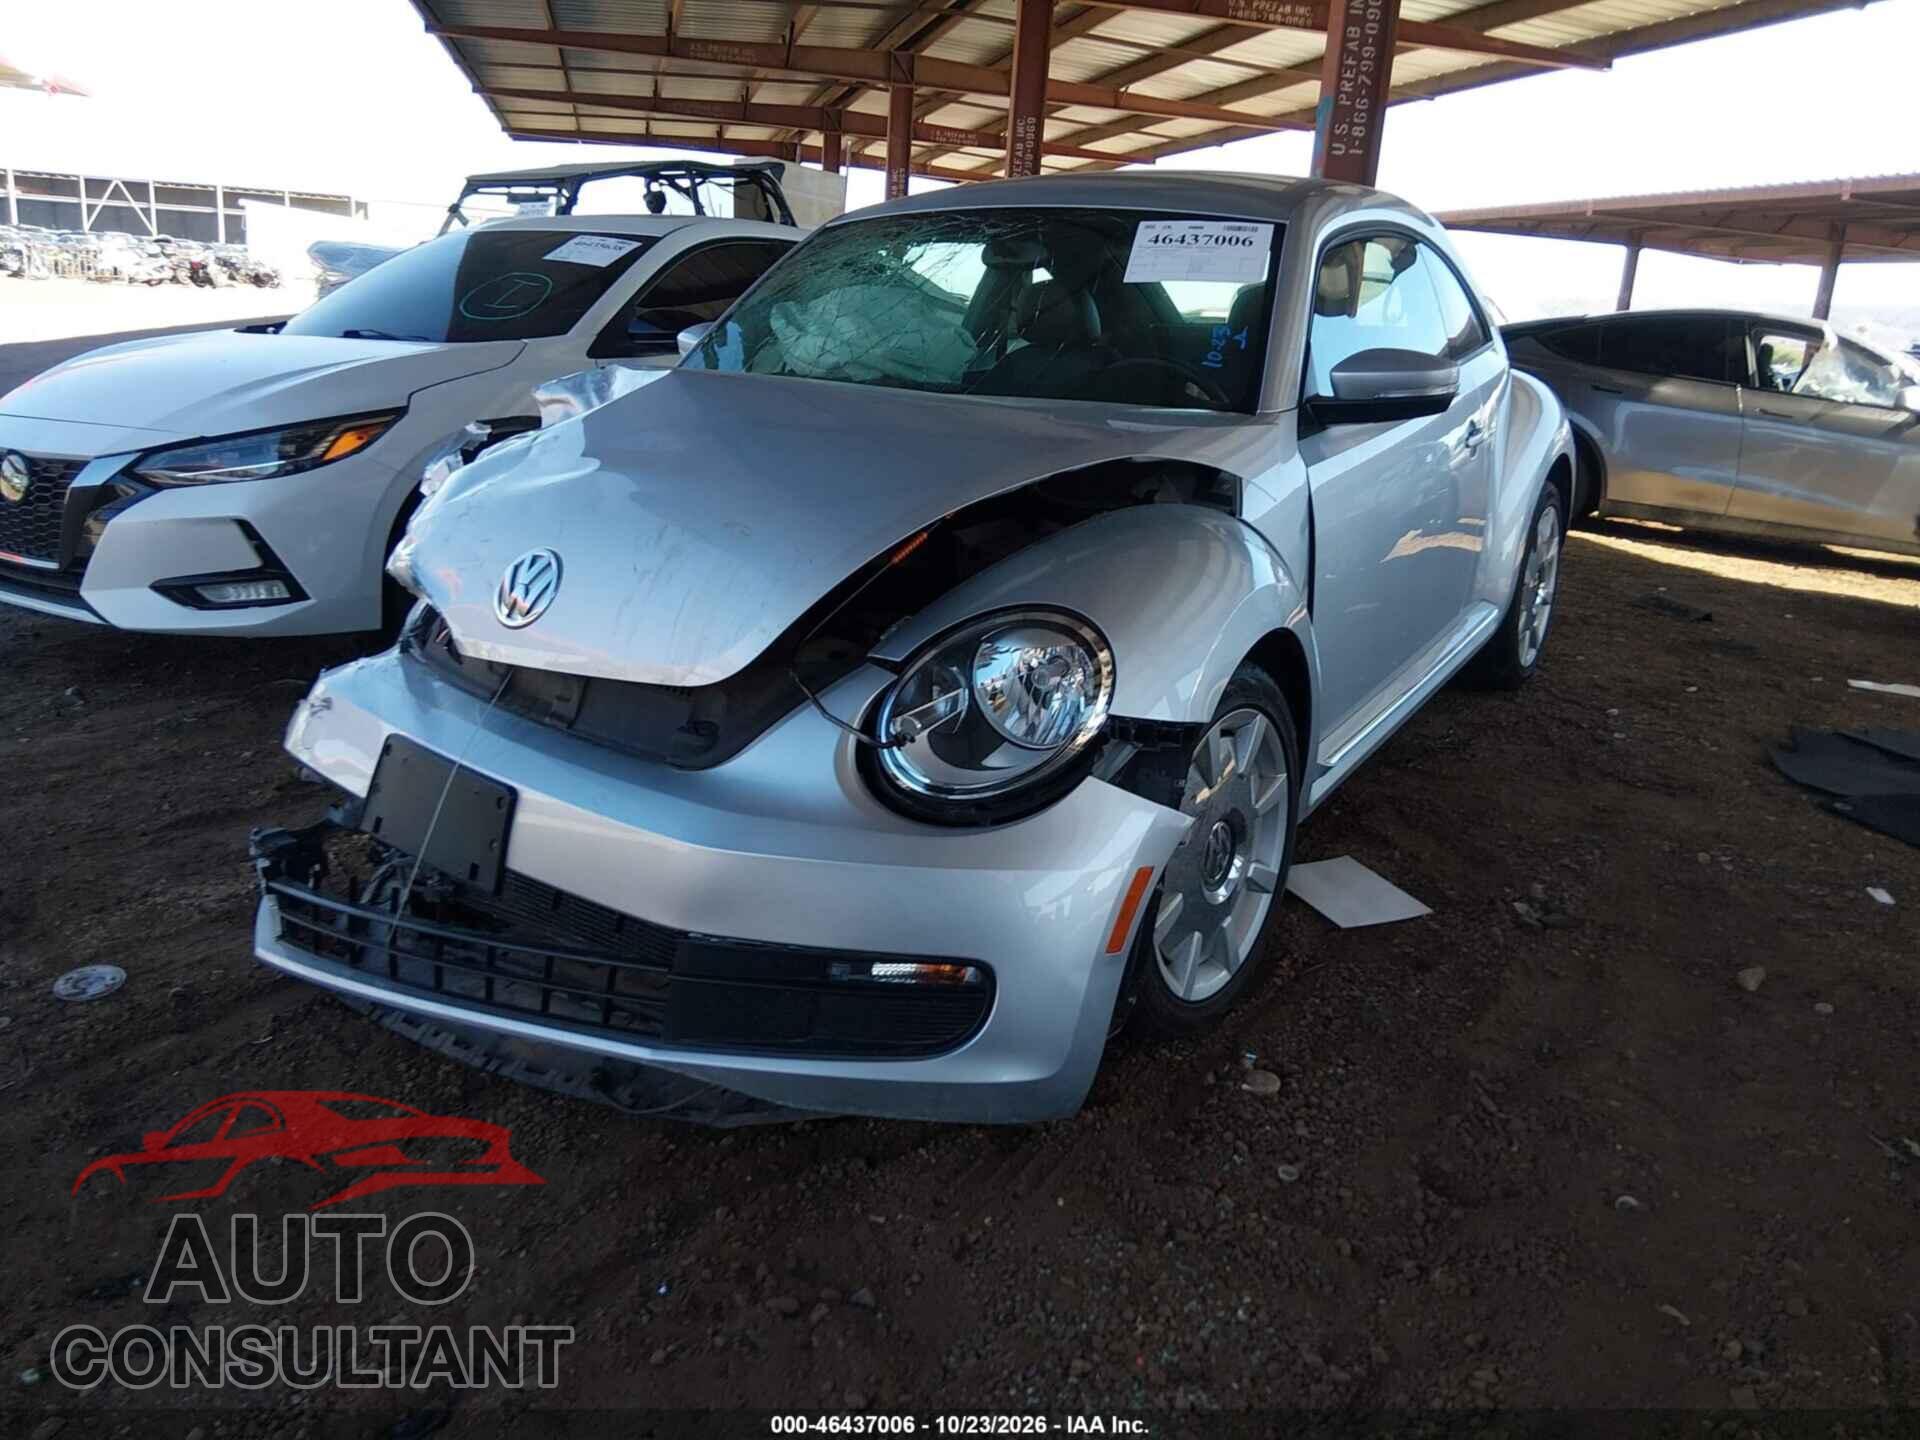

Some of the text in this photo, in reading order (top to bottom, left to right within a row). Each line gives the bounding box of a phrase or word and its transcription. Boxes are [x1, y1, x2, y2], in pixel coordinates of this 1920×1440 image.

[1338, 25, 1362, 105] PREFAB
[1330, 118, 1351, 156] U.S.
[1147, 233, 1254, 248] 46437006
